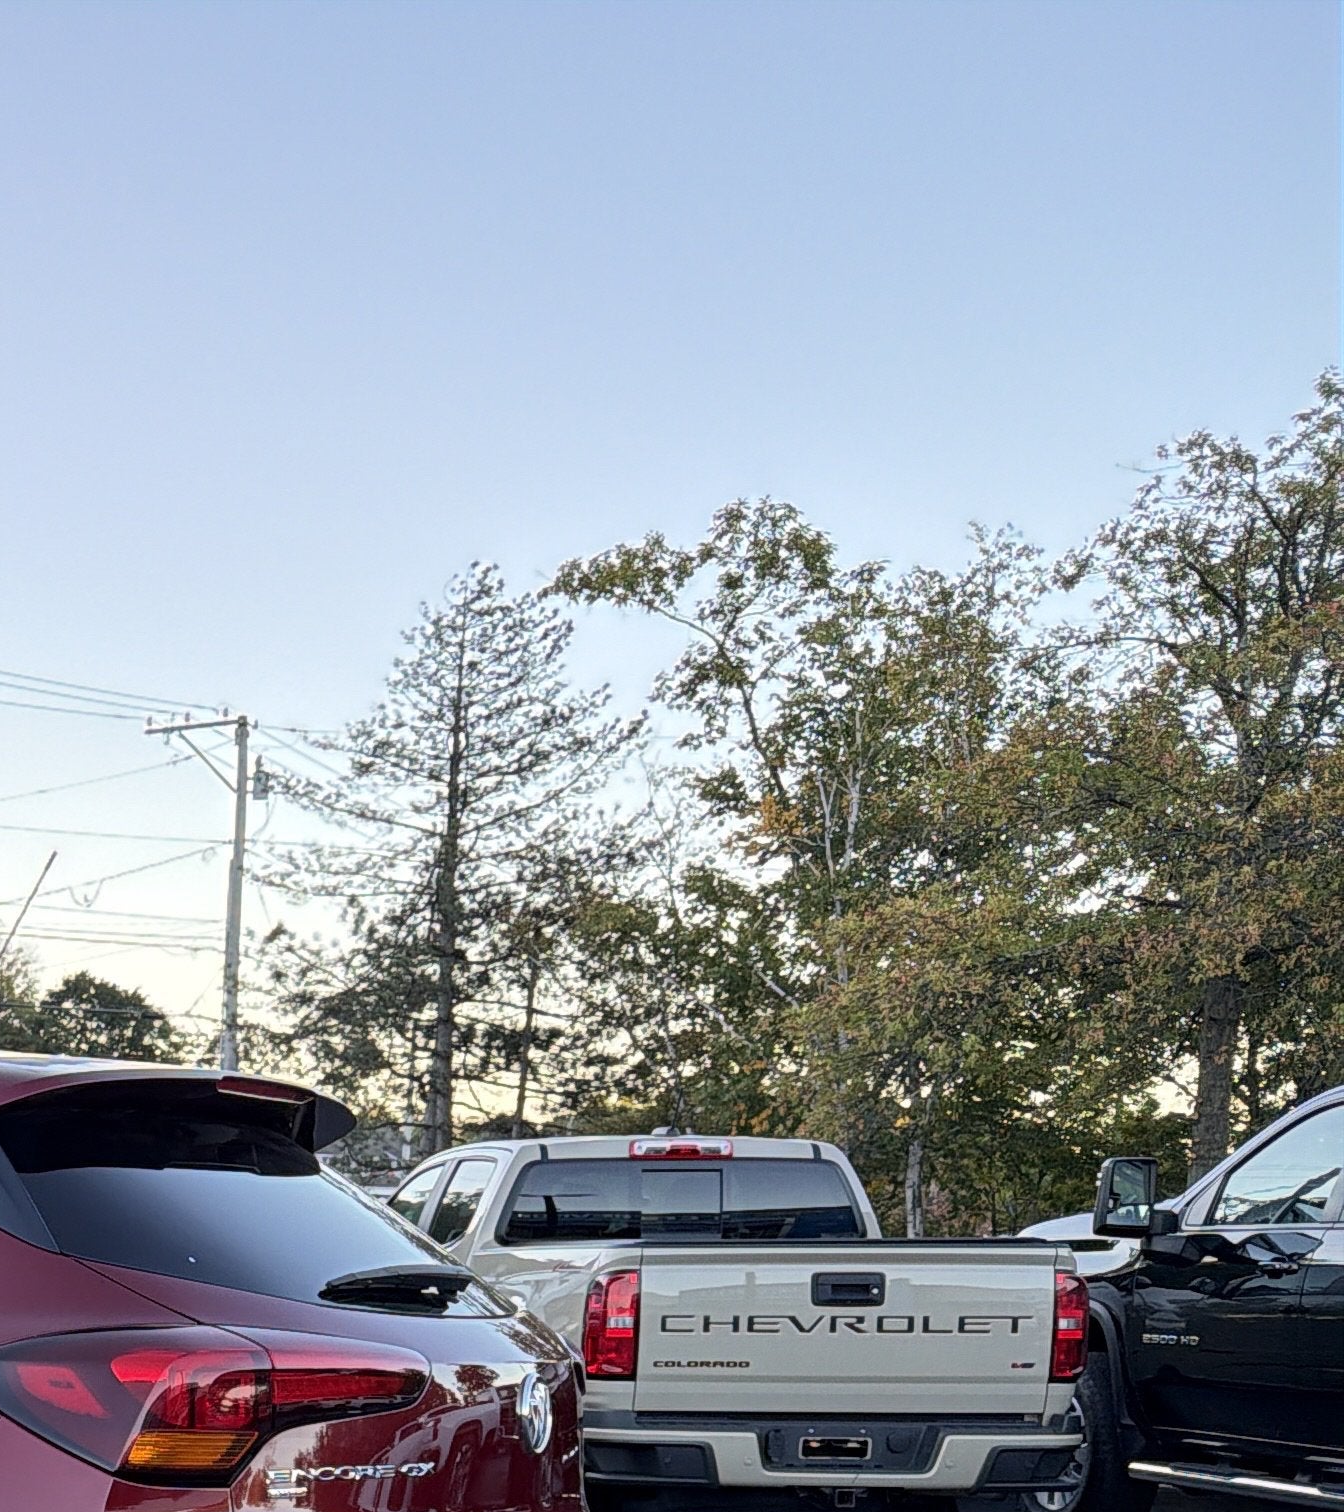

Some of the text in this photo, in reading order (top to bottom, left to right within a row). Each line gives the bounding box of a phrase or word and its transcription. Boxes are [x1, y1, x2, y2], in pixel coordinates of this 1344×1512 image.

[660, 1315, 1033, 1334] CHEVROLET
[1142, 1333, 1200, 1346] 2500 HD
[652, 1360, 750, 1369] COLORADO
[266, 1462, 434, 1485] ENCORE GX
